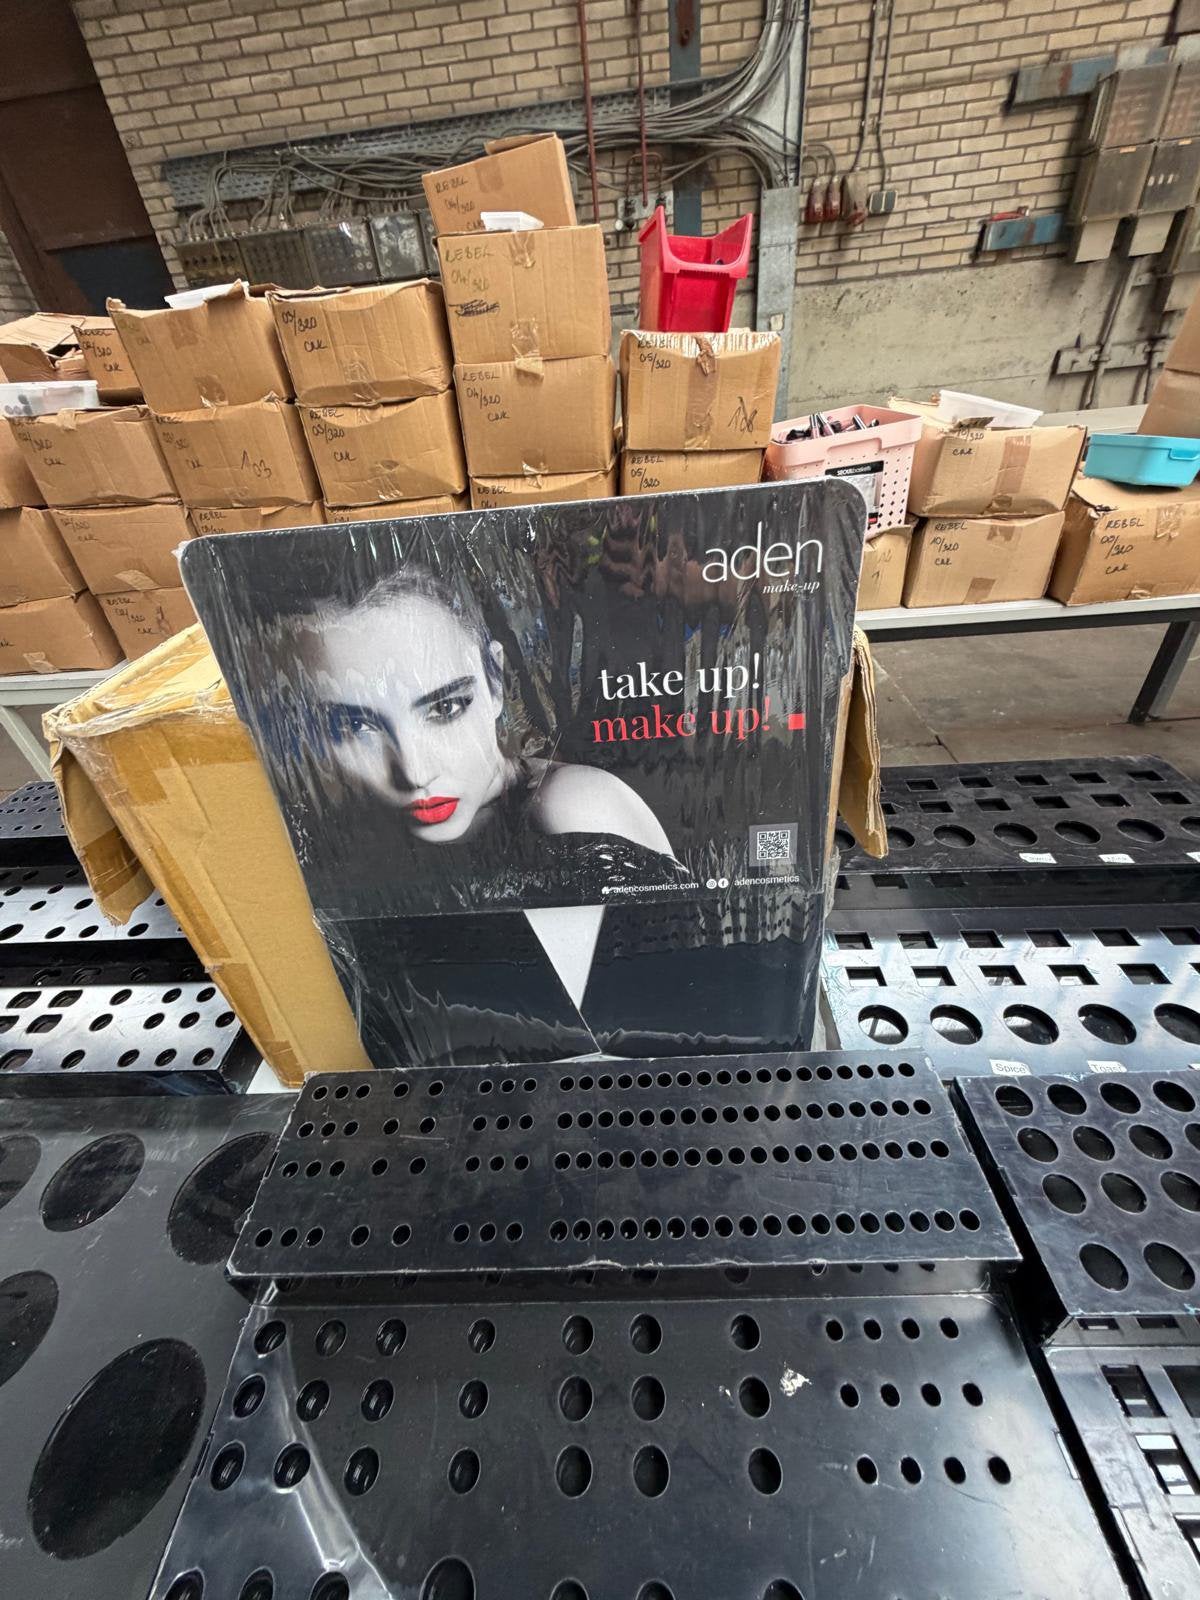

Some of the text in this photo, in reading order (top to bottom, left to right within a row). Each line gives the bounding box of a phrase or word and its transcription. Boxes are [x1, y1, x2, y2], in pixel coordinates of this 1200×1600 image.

[934, 521, 968, 532] REBEL
[1105, 517, 1145, 530] REBEL
[701, 520, 823, 583] aden
[762, 579, 820, 594] make-up
[597, 652, 761, 701] take up!
[591, 695, 771, 744] make up!
[733, 874, 800, 887] adencosmetics
